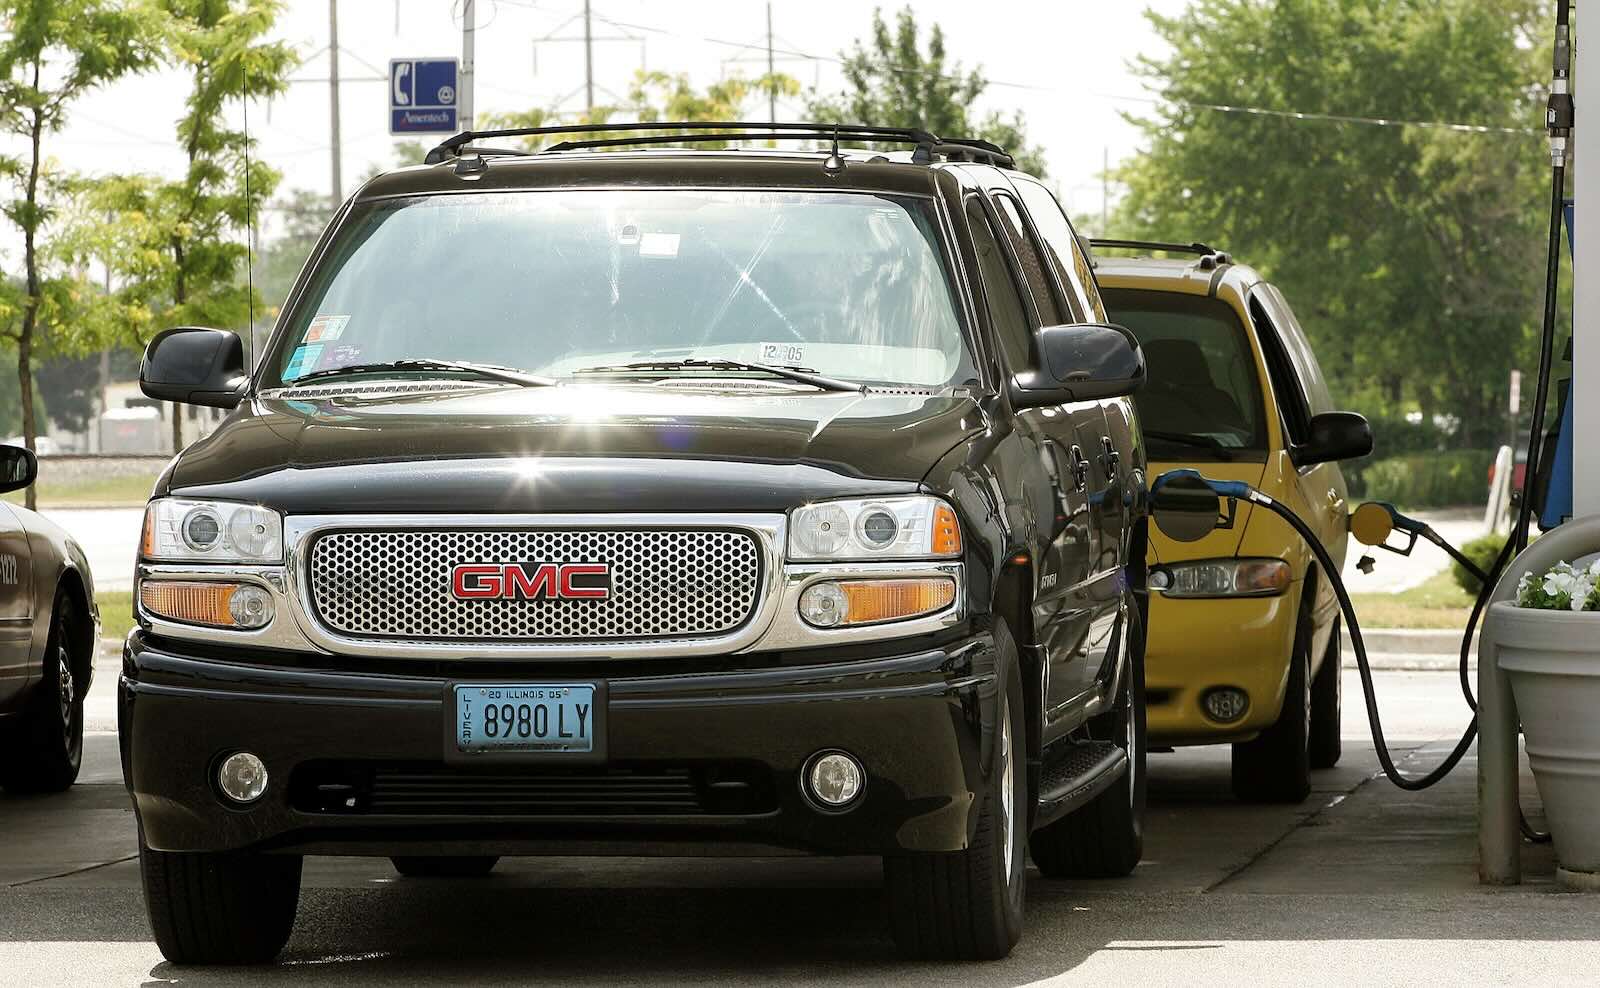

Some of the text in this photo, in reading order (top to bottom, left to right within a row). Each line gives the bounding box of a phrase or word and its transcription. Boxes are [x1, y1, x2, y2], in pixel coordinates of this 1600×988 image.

[452, 563, 609, 599] GMC
[488, 690, 562, 699] 20 ILLINOIS 05
[484, 703, 589, 738] 8980 LY
